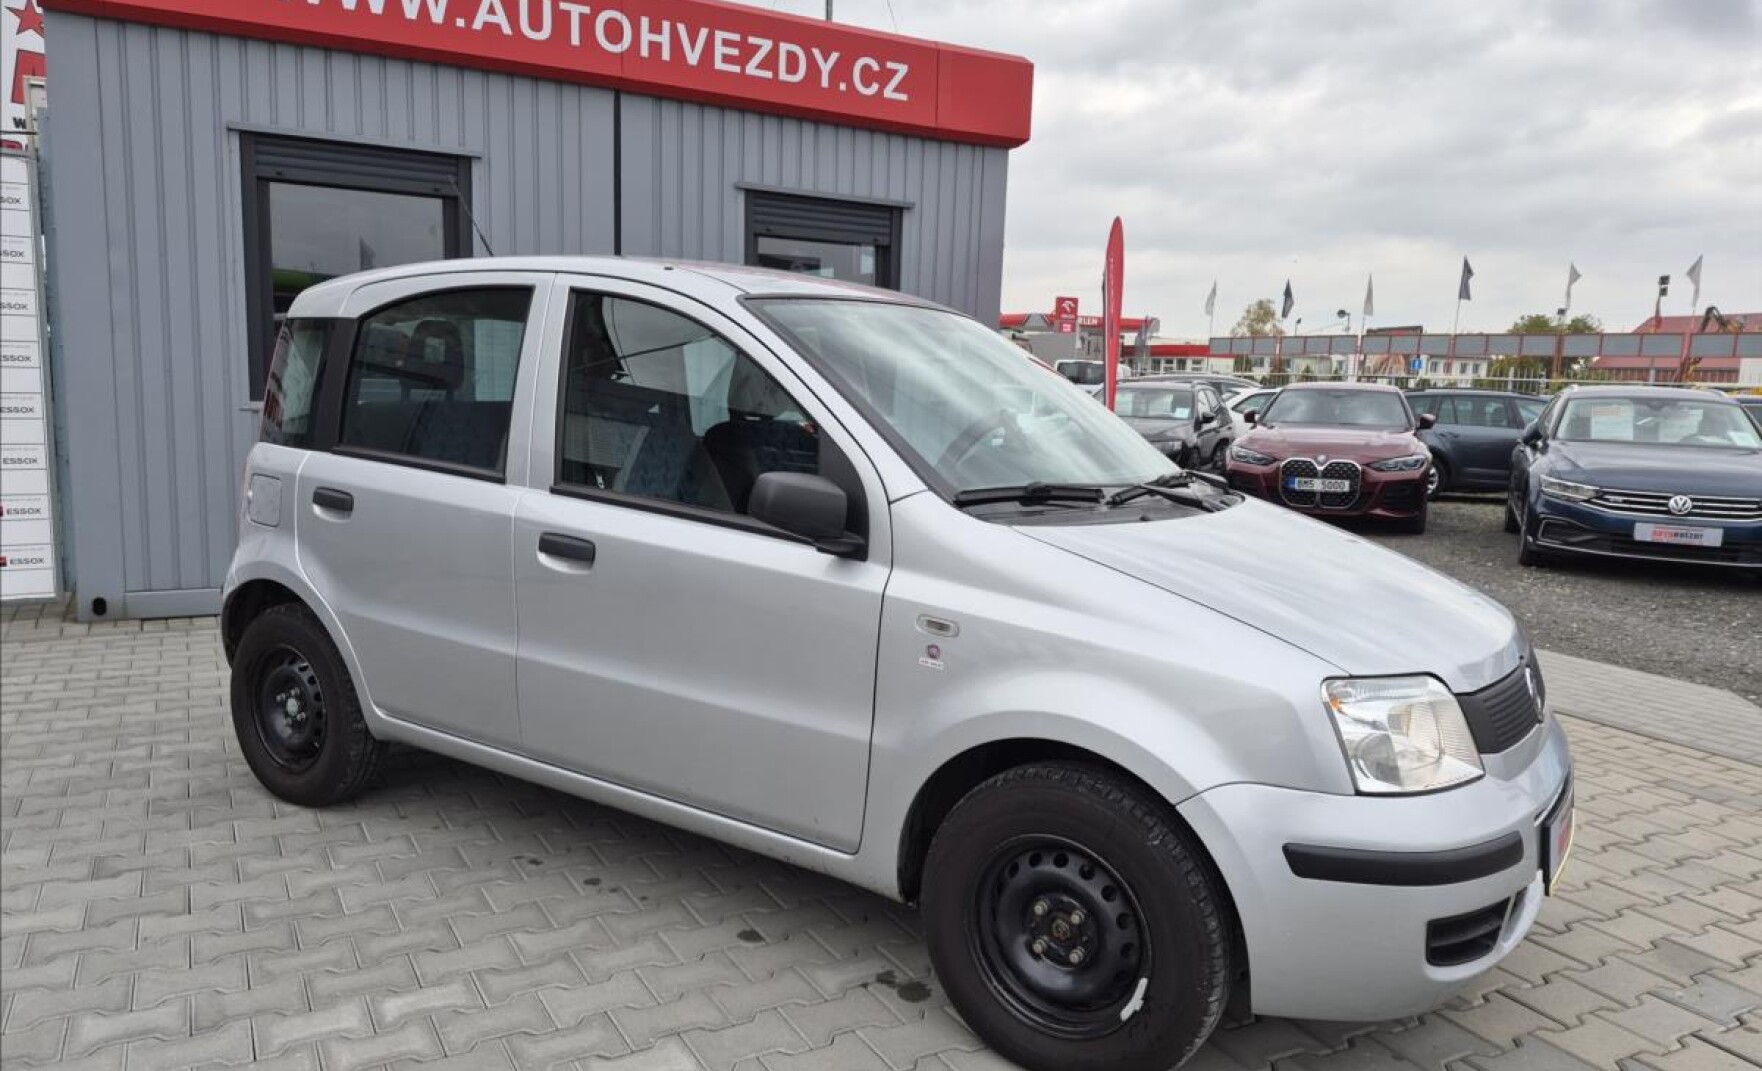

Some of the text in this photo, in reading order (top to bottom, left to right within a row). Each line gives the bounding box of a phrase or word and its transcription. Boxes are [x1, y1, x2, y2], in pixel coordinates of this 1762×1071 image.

[276, 0, 910, 101] W.AUTOHVEZDY.CZ
[0, 249, 25, 258] SOX
[0, 354, 32, 363] SSOX
[6, 507, 42, 515] ESSOX
[9, 557, 45, 565] ESSOX
